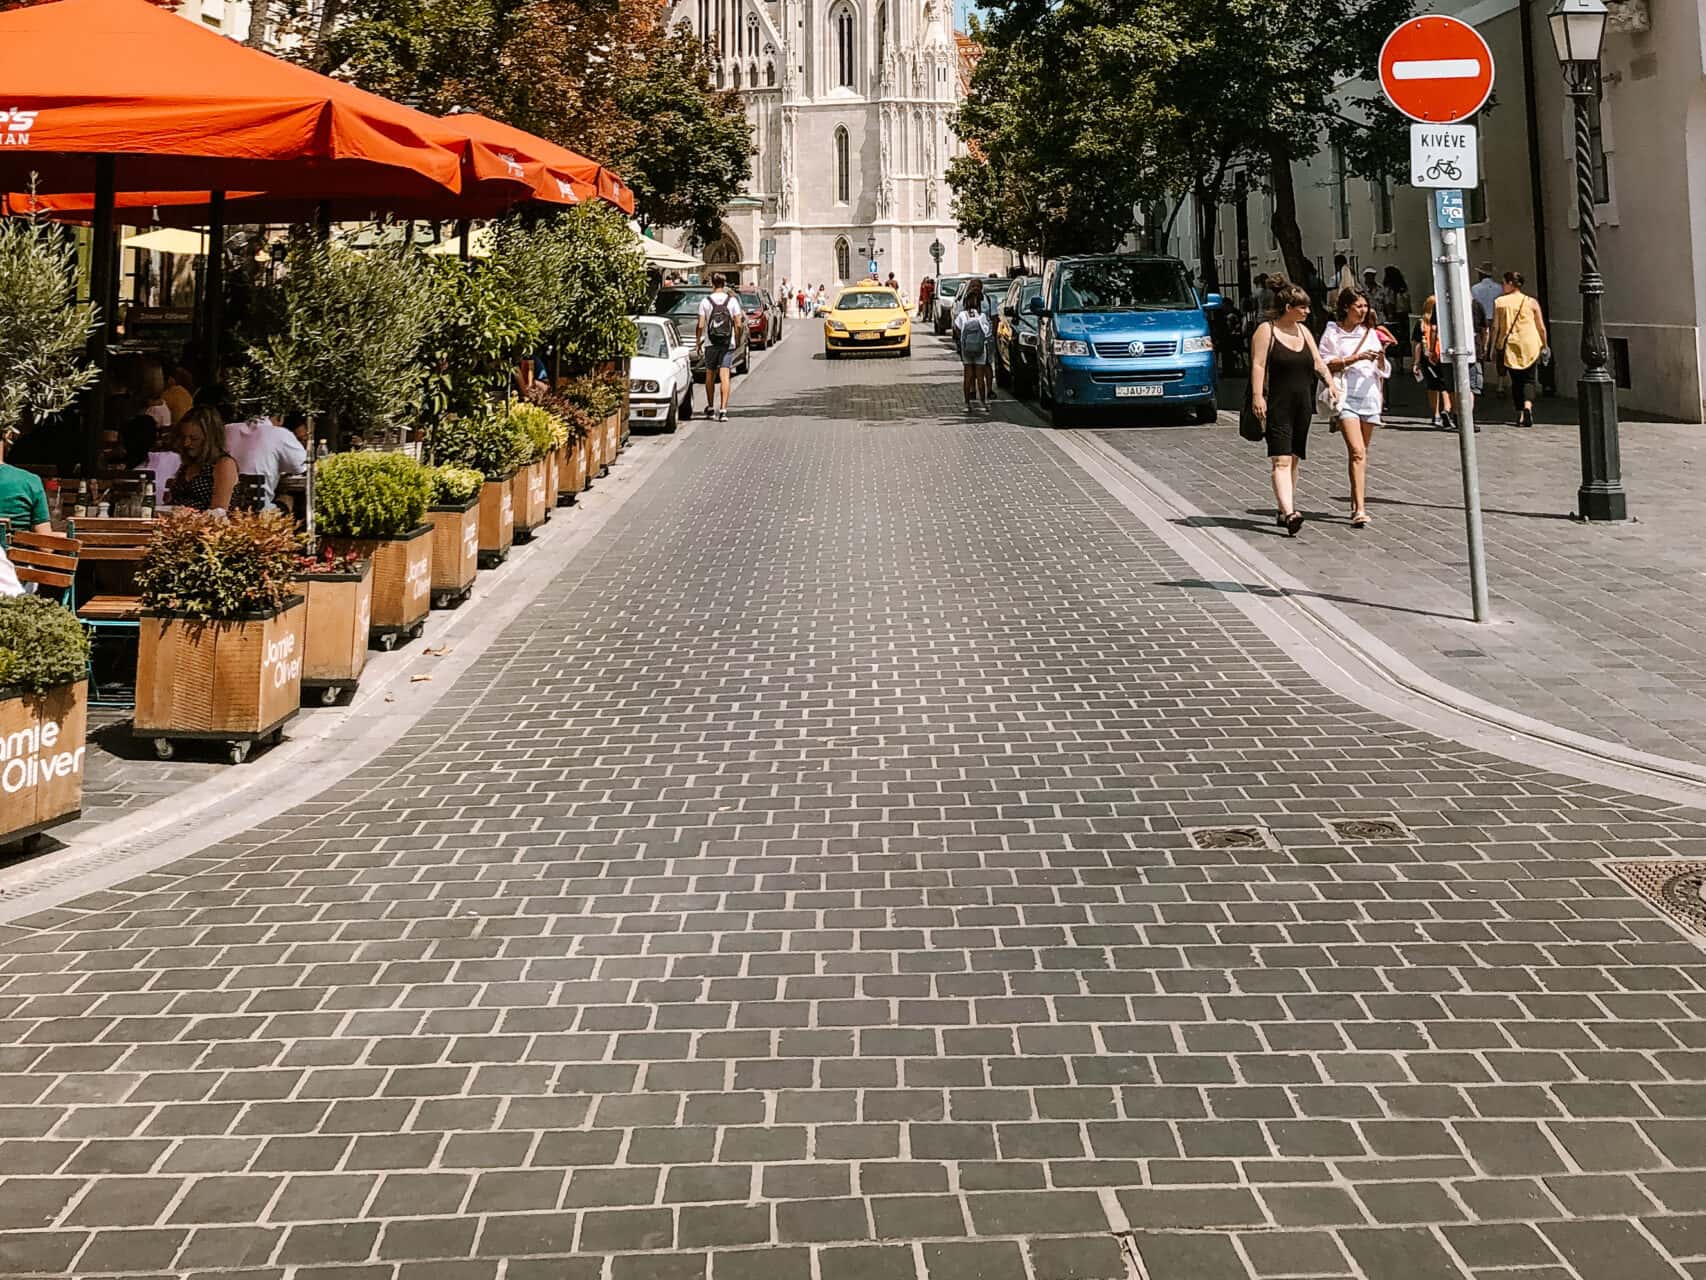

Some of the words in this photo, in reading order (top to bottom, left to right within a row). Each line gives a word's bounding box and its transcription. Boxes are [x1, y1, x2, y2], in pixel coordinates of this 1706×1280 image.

[1421, 131, 1466, 148] KIVÉVE
[264, 631, 295, 667] Jamie
[274, 656, 302, 688] Oliver
[2, 746, 86, 792] Oliver
